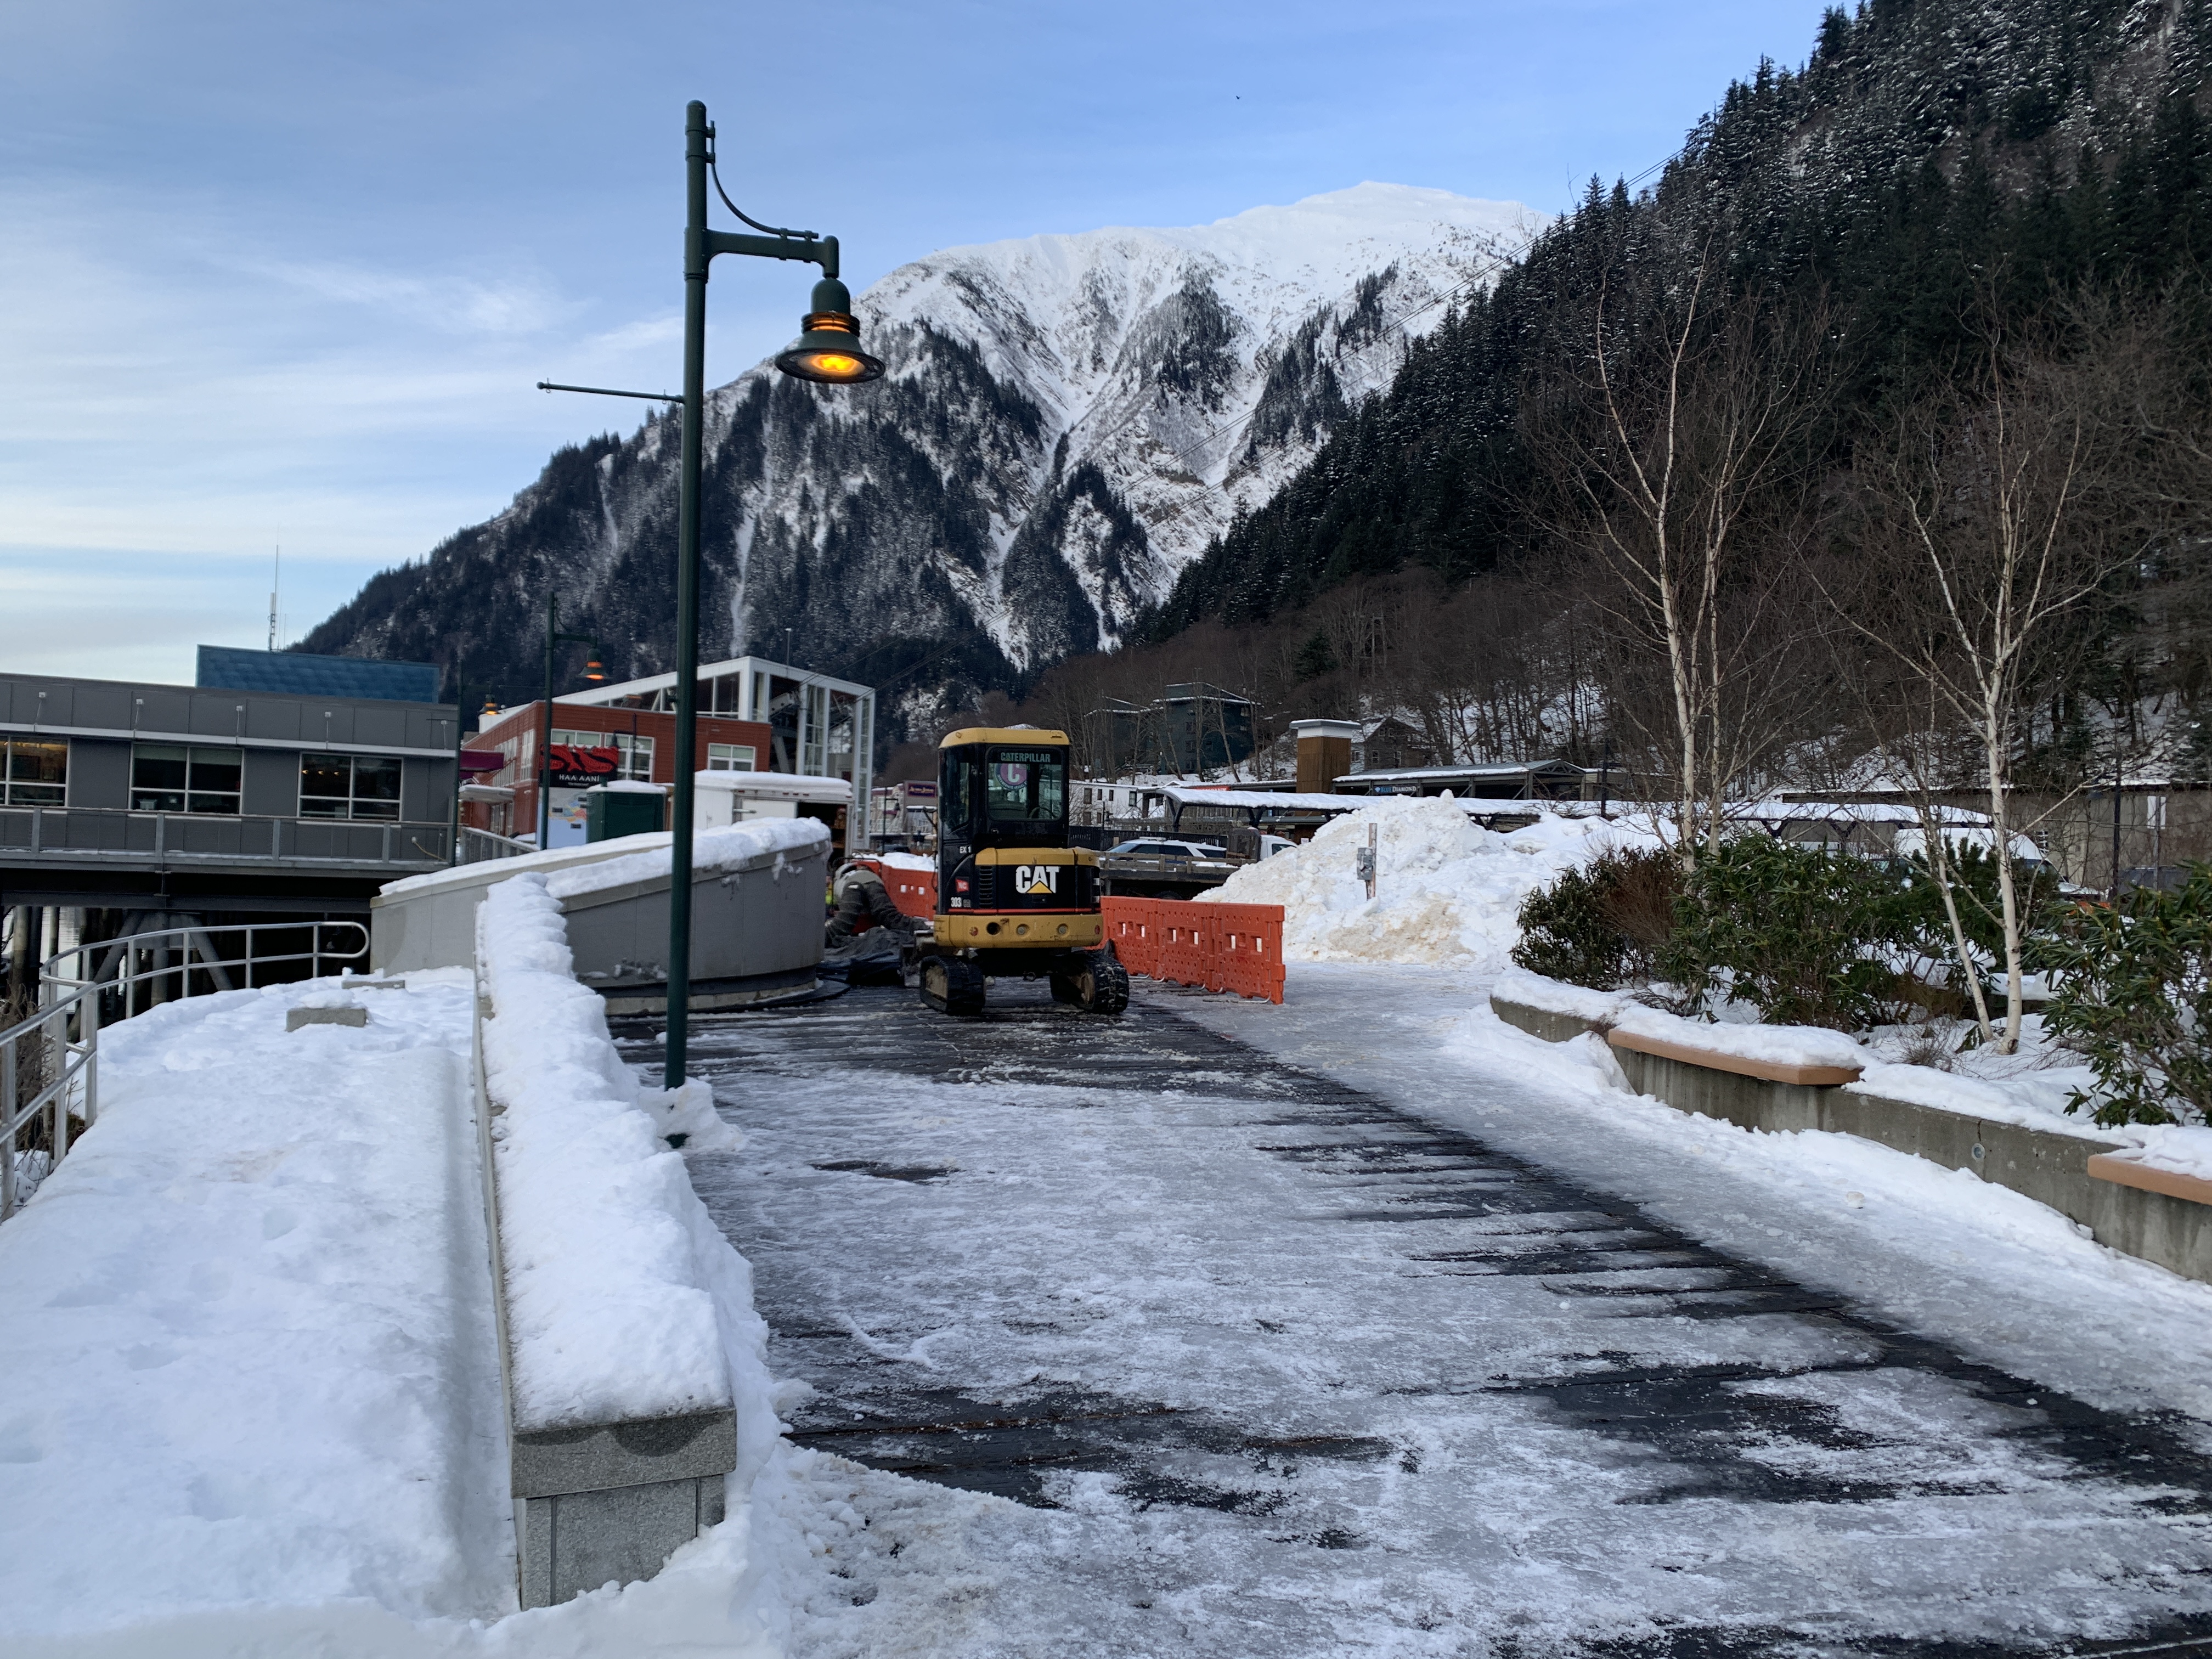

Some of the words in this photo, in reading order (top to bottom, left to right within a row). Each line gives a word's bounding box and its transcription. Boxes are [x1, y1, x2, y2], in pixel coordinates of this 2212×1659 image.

[1001, 752, 1051, 763] CATERPILLAR
[1015, 866, 1059, 893] CAT
[951, 897, 962, 907] 303
